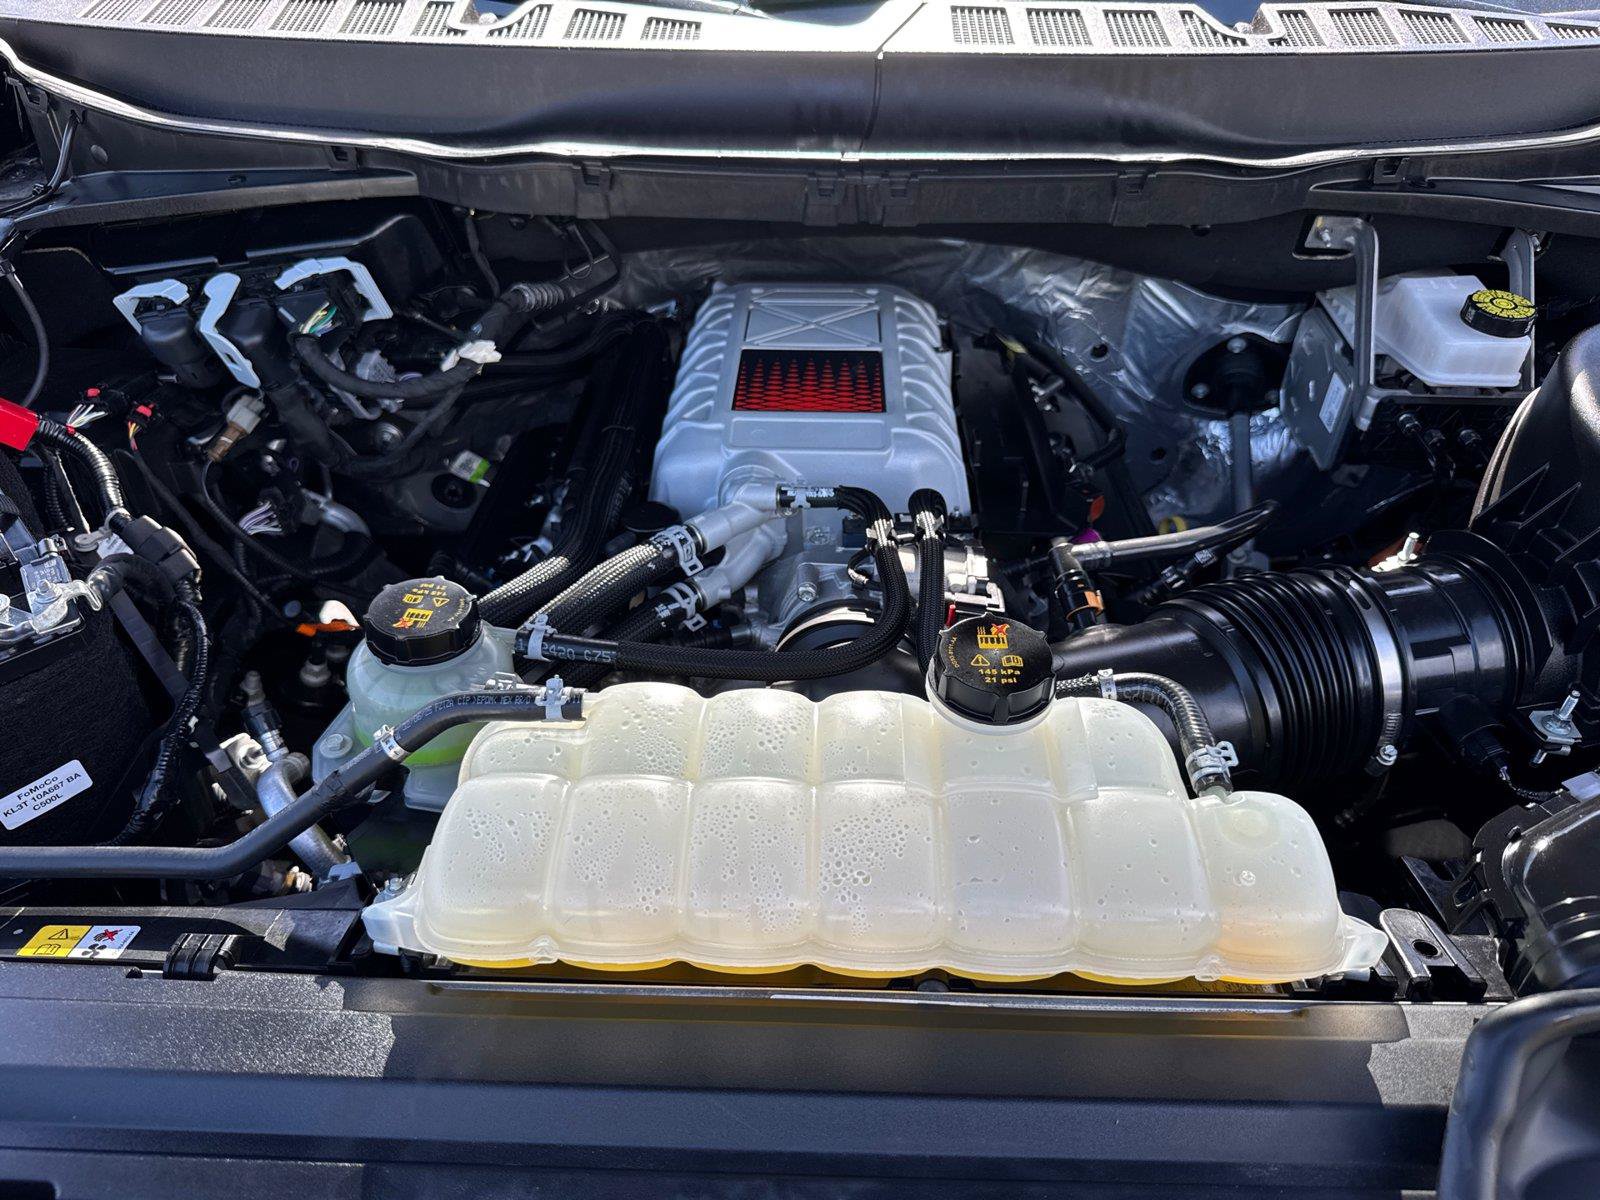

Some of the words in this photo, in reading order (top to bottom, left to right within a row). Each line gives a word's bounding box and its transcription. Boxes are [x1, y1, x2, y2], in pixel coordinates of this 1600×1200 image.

[3, 800, 29, 818] KL3T
[31, 781, 65, 803] 10A687
[66, 772, 82, 783] BA
[17, 776, 59, 801] FoMoCo
[32, 793, 63, 811] C500L
